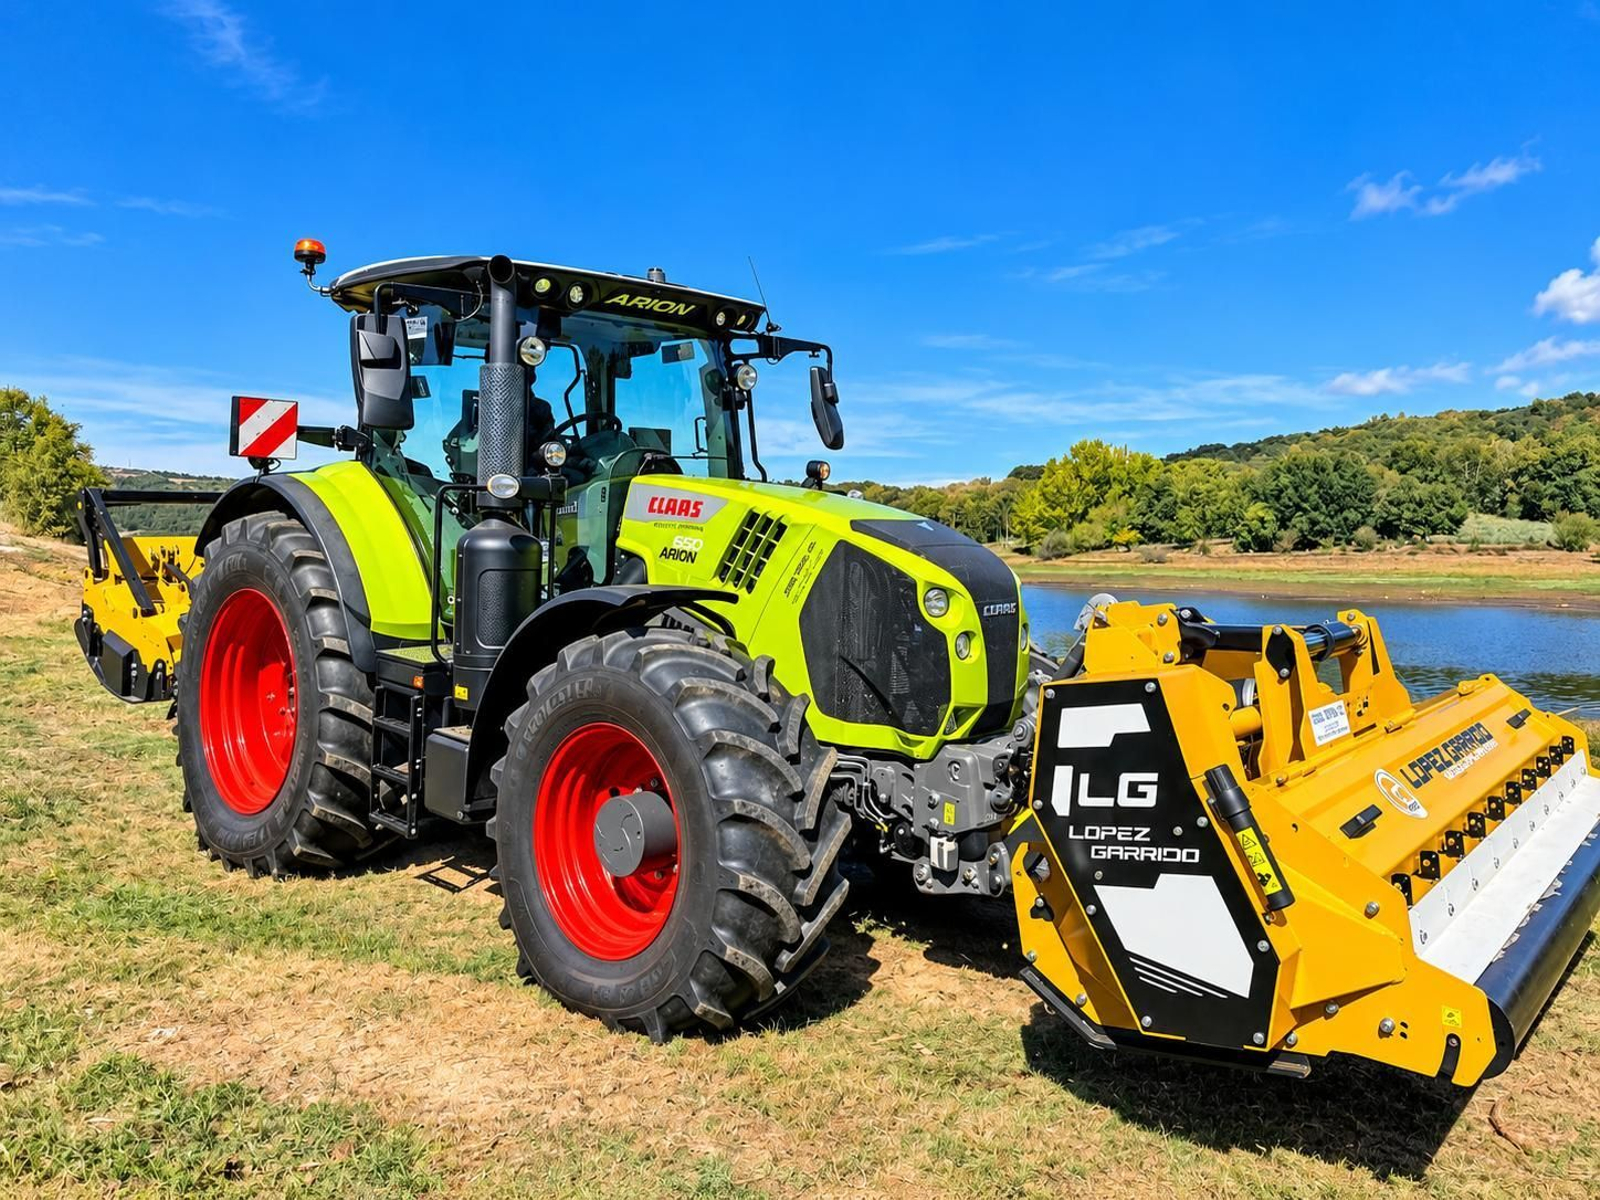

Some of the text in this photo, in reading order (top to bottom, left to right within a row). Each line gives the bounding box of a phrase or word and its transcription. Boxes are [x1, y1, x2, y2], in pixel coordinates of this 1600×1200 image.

[604, 293, 696, 315] ARION
[647, 496, 704, 518] CLAAS
[673, 535, 704, 552] 650
[659, 546, 698, 564] ARION
[1399, 747, 1454, 789] LOPEZ
[1068, 825, 1151, 841] LOPEZ
[1091, 845, 1200, 863] GARRIDO
